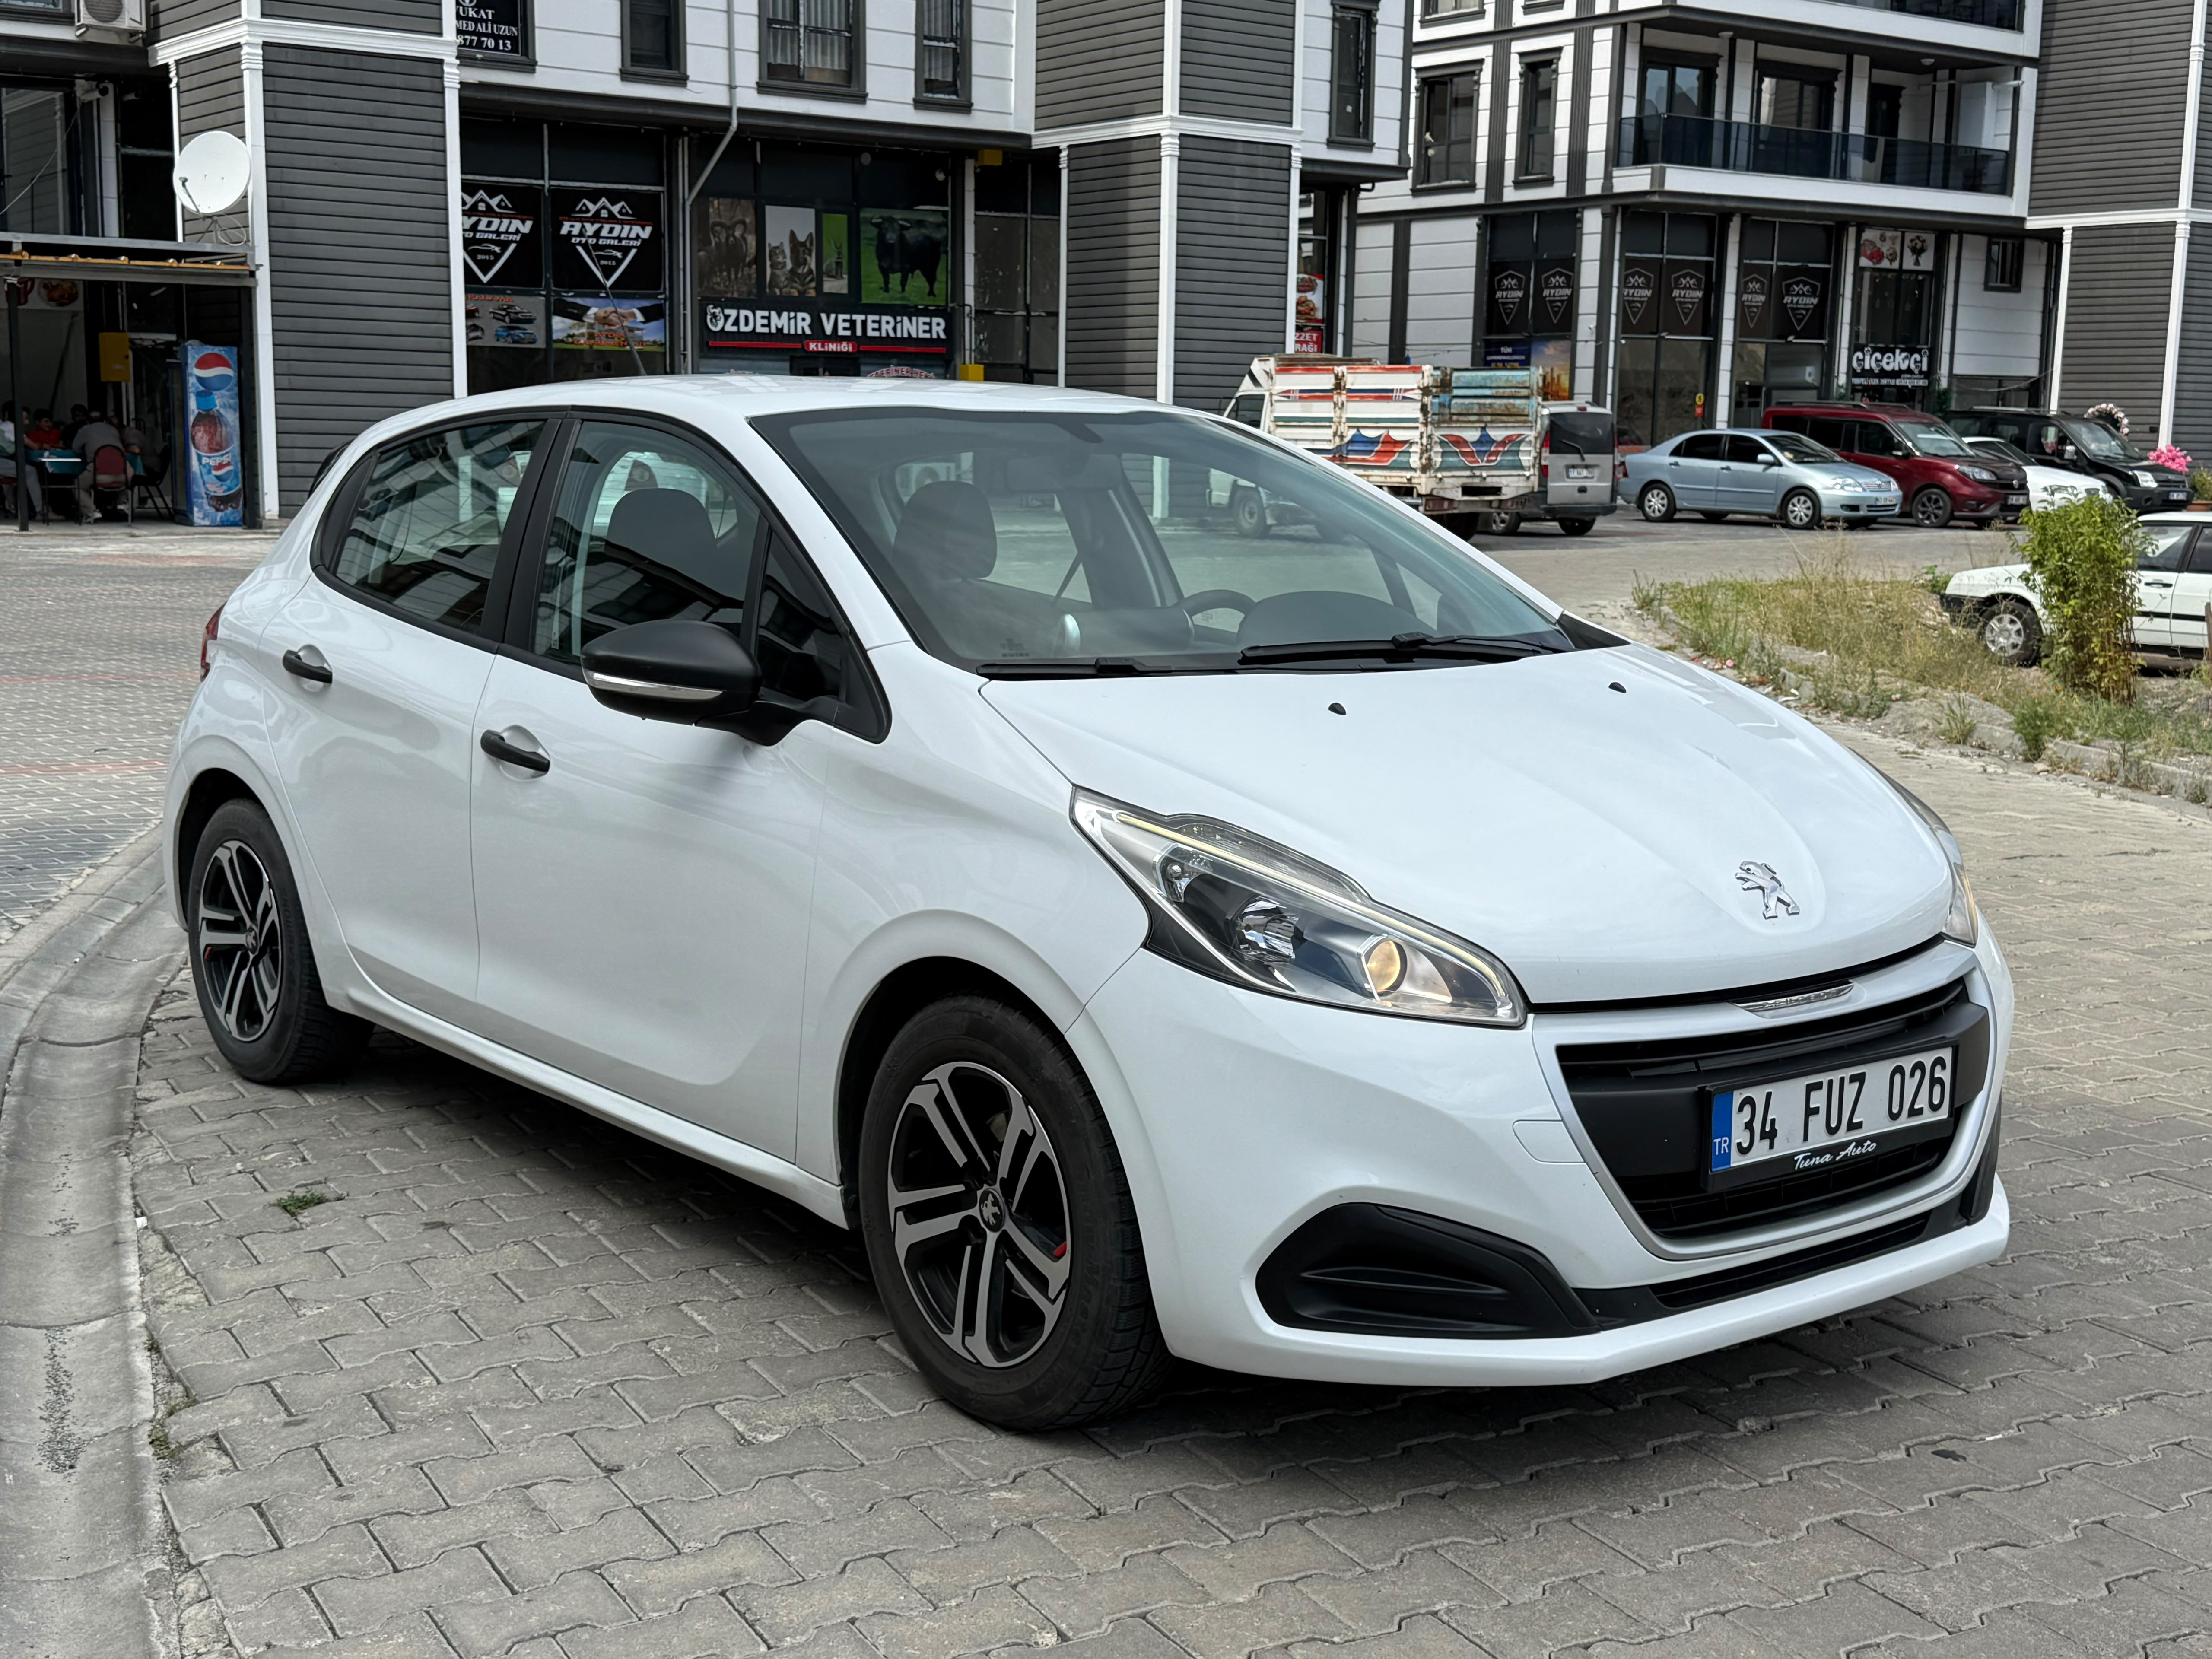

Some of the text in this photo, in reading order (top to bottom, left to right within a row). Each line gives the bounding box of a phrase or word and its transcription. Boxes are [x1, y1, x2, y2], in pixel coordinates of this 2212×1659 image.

[476, 22, 491, 33] ALİ
[493, 24, 518, 36] UZUN
[481, 37, 495, 48] 70
[498, 39, 512, 51] 13
[560, 221, 652, 239] AYDIN
[1495, 290, 1523, 299] AYDIN
[1543, 288, 1572, 297] AYDIN
[1672, 289, 1704, 298] AYDIN
[1742, 294, 1766, 302] AYDIN
[1783, 296, 1819, 305] AYDIN
[820, 313, 947, 339] VETERİNER
[1736, 1056, 1947, 1155] 34 FUZ 026
[1713, 1137, 1729, 1156] TR
[1794, 1140, 1877, 1170] Tuna Auto
